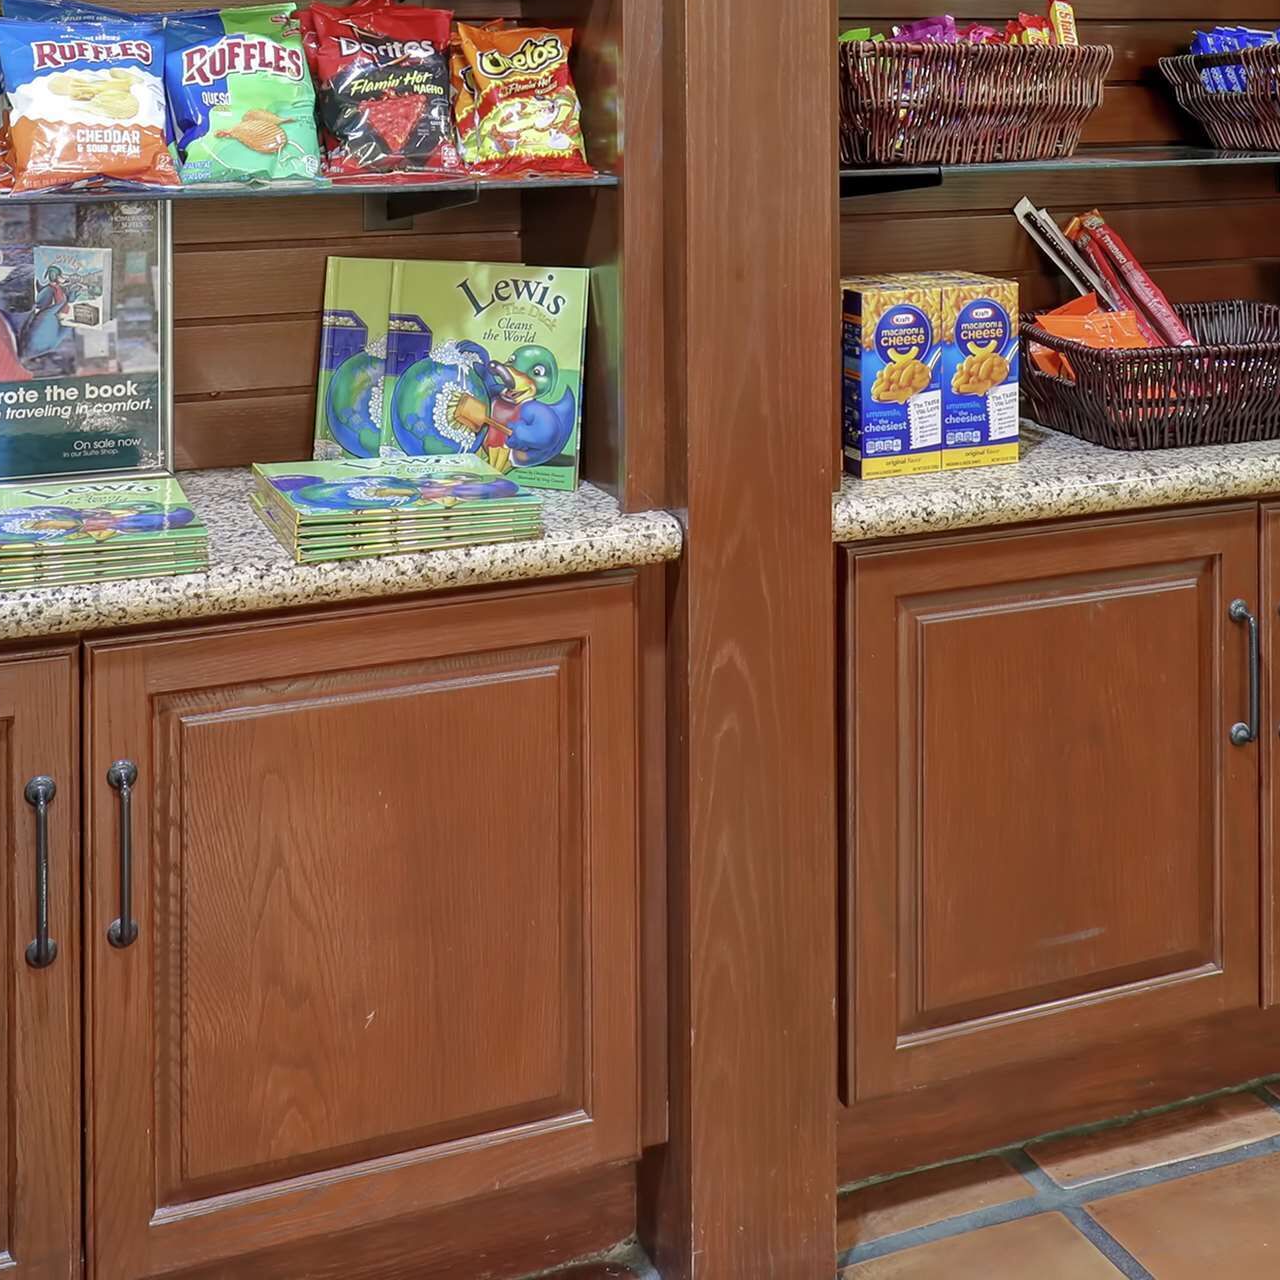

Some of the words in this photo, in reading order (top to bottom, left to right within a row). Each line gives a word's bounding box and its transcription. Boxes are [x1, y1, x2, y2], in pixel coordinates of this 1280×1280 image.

[34, 42, 152, 69] RUFFLES
[340, 38, 434, 58] Doritos
[183, 39, 302, 84] RUFFLES
[480, 39, 561, 73] Cheetos
[351, 75, 404, 95] Flamin'
[405, 72, 430, 85] Hot
[414, 84, 444, 95] NACHO
[77, 130, 140, 144] CHEDDAR
[85, 144, 108, 154] SOUR
[111, 144, 141, 155] CREAM
[456, 273, 567, 318] Lewis
[497, 317, 533, 331] Cleans
[482, 330, 500, 341] the
[503, 330, 536, 344] World
[881, 328, 919, 336] macaroni
[45, 385, 79, 401] the
[85, 381, 138, 398] book
[6, 404, 72, 420] traveling
[76, 402, 89, 415] in
[90, 398, 153, 413] comfort.
[945, 414, 986, 424] cheesiest
[865, 421, 907, 433] cheesiest
[74, 440, 92, 450] On
[94, 440, 116, 449] sale
[118, 438, 141, 446] now
[22, 483, 160, 500] Lewis
